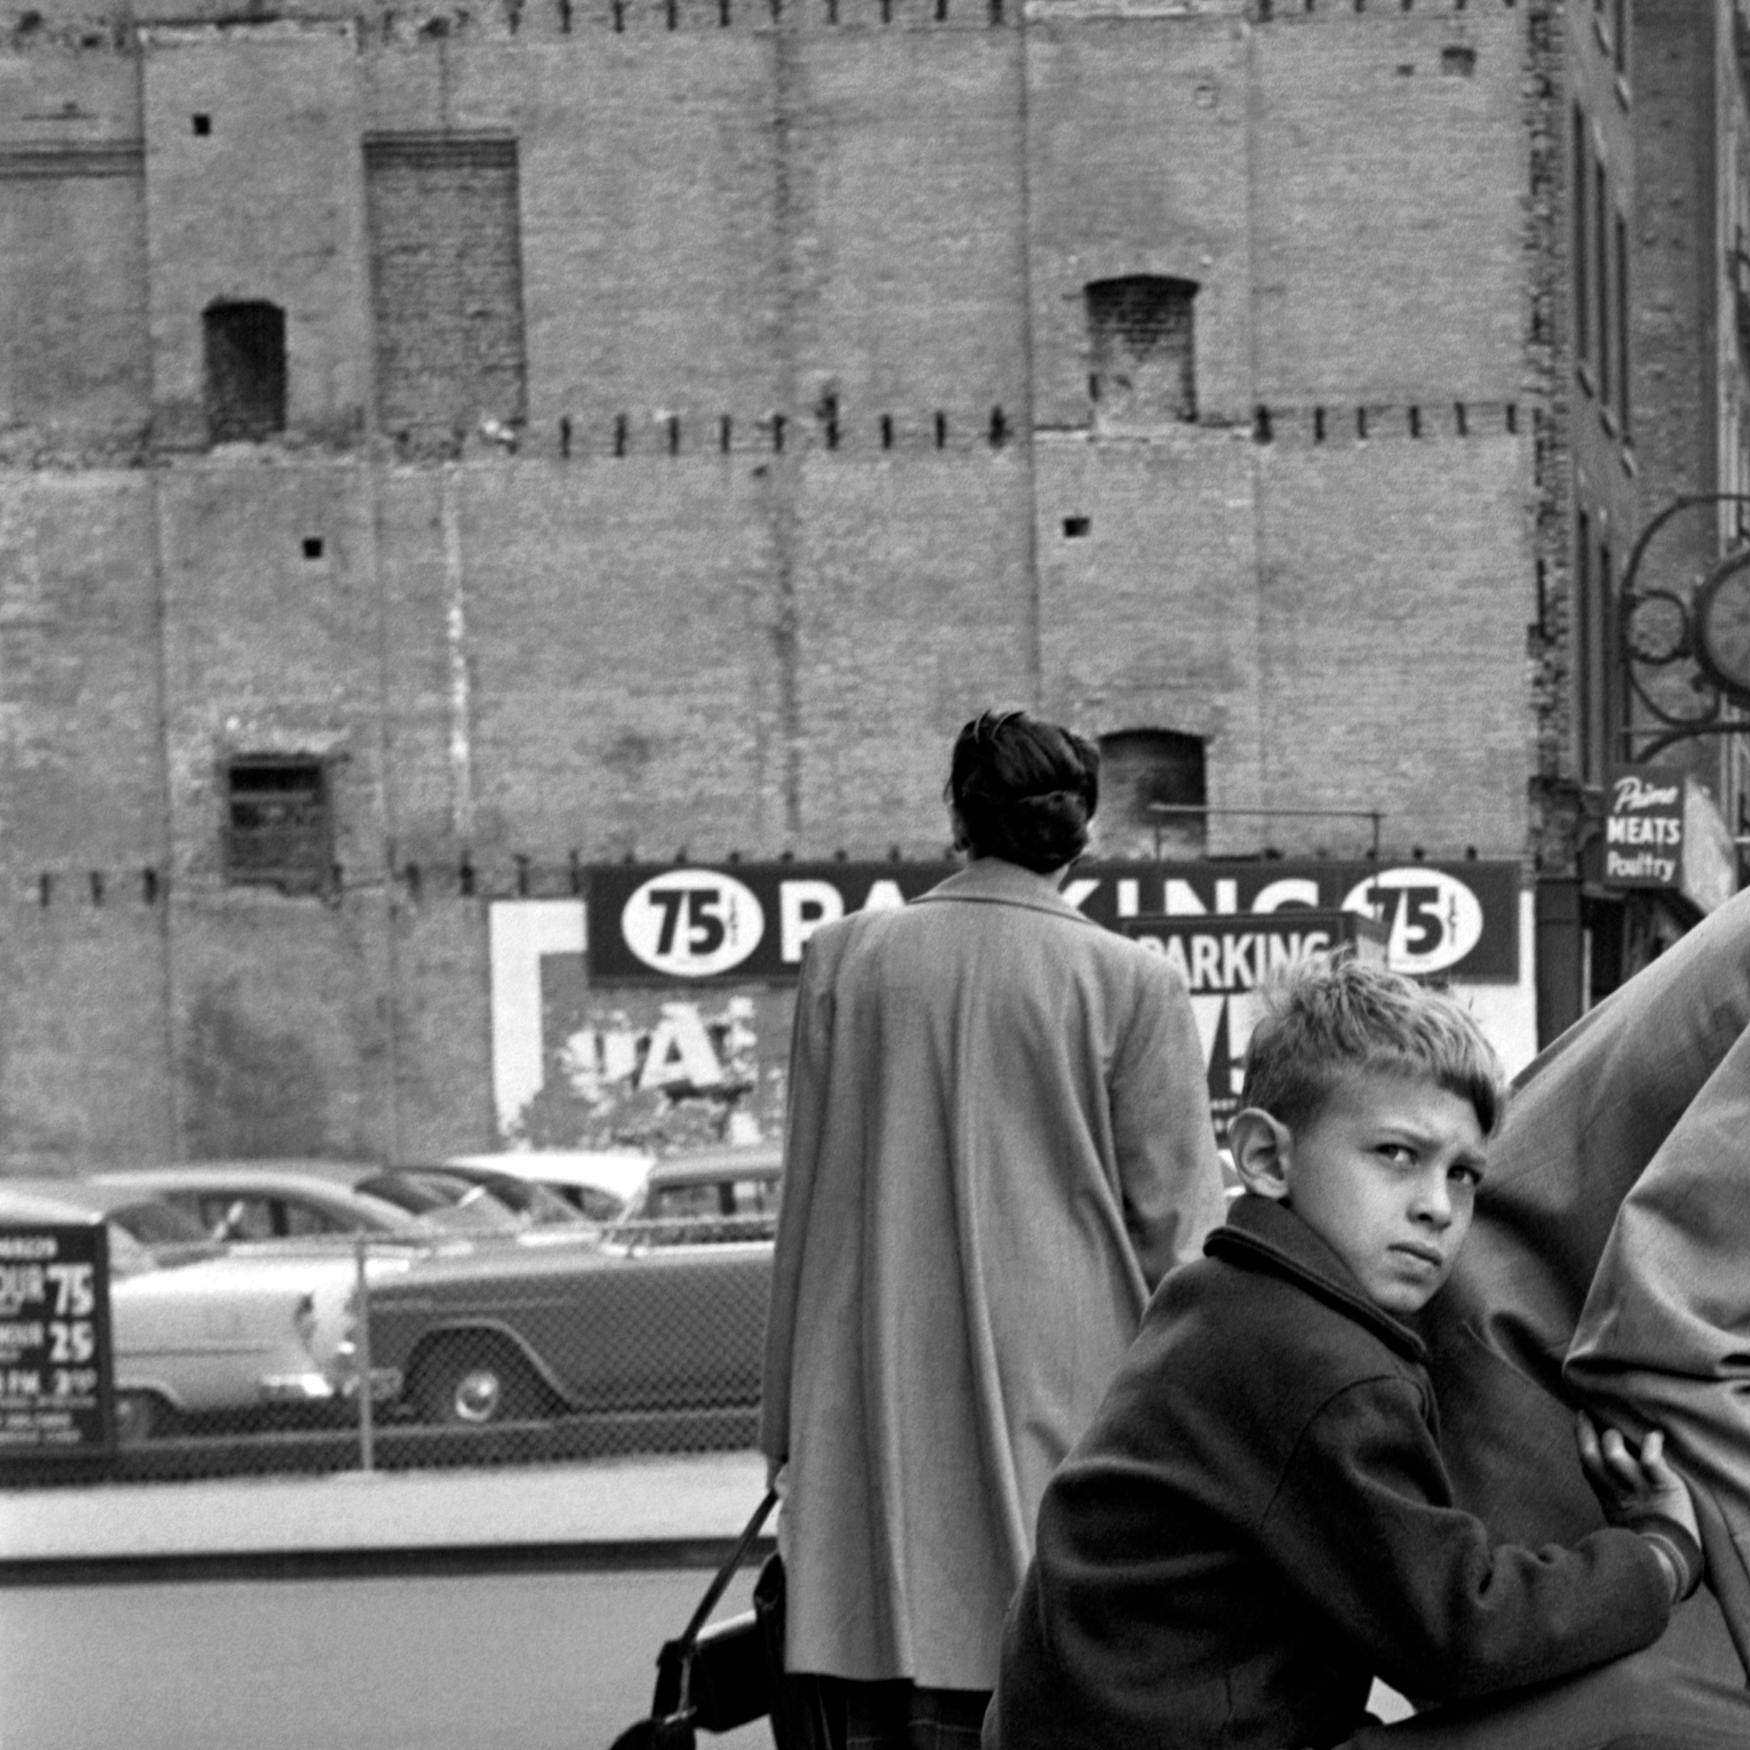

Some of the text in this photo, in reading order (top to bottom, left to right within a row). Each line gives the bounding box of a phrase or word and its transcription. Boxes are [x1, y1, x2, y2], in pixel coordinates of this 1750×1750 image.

[1612, 775, 1679, 814] Prime
[1606, 816, 1681, 845] MEATS
[1606, 850, 1676, 883] Poultry
[649, 888, 725, 956] 75
[1366, 886, 1444, 956] 75
[46, 1264, 95, 1316] 75
[48, 1320, 95, 1363] 25
